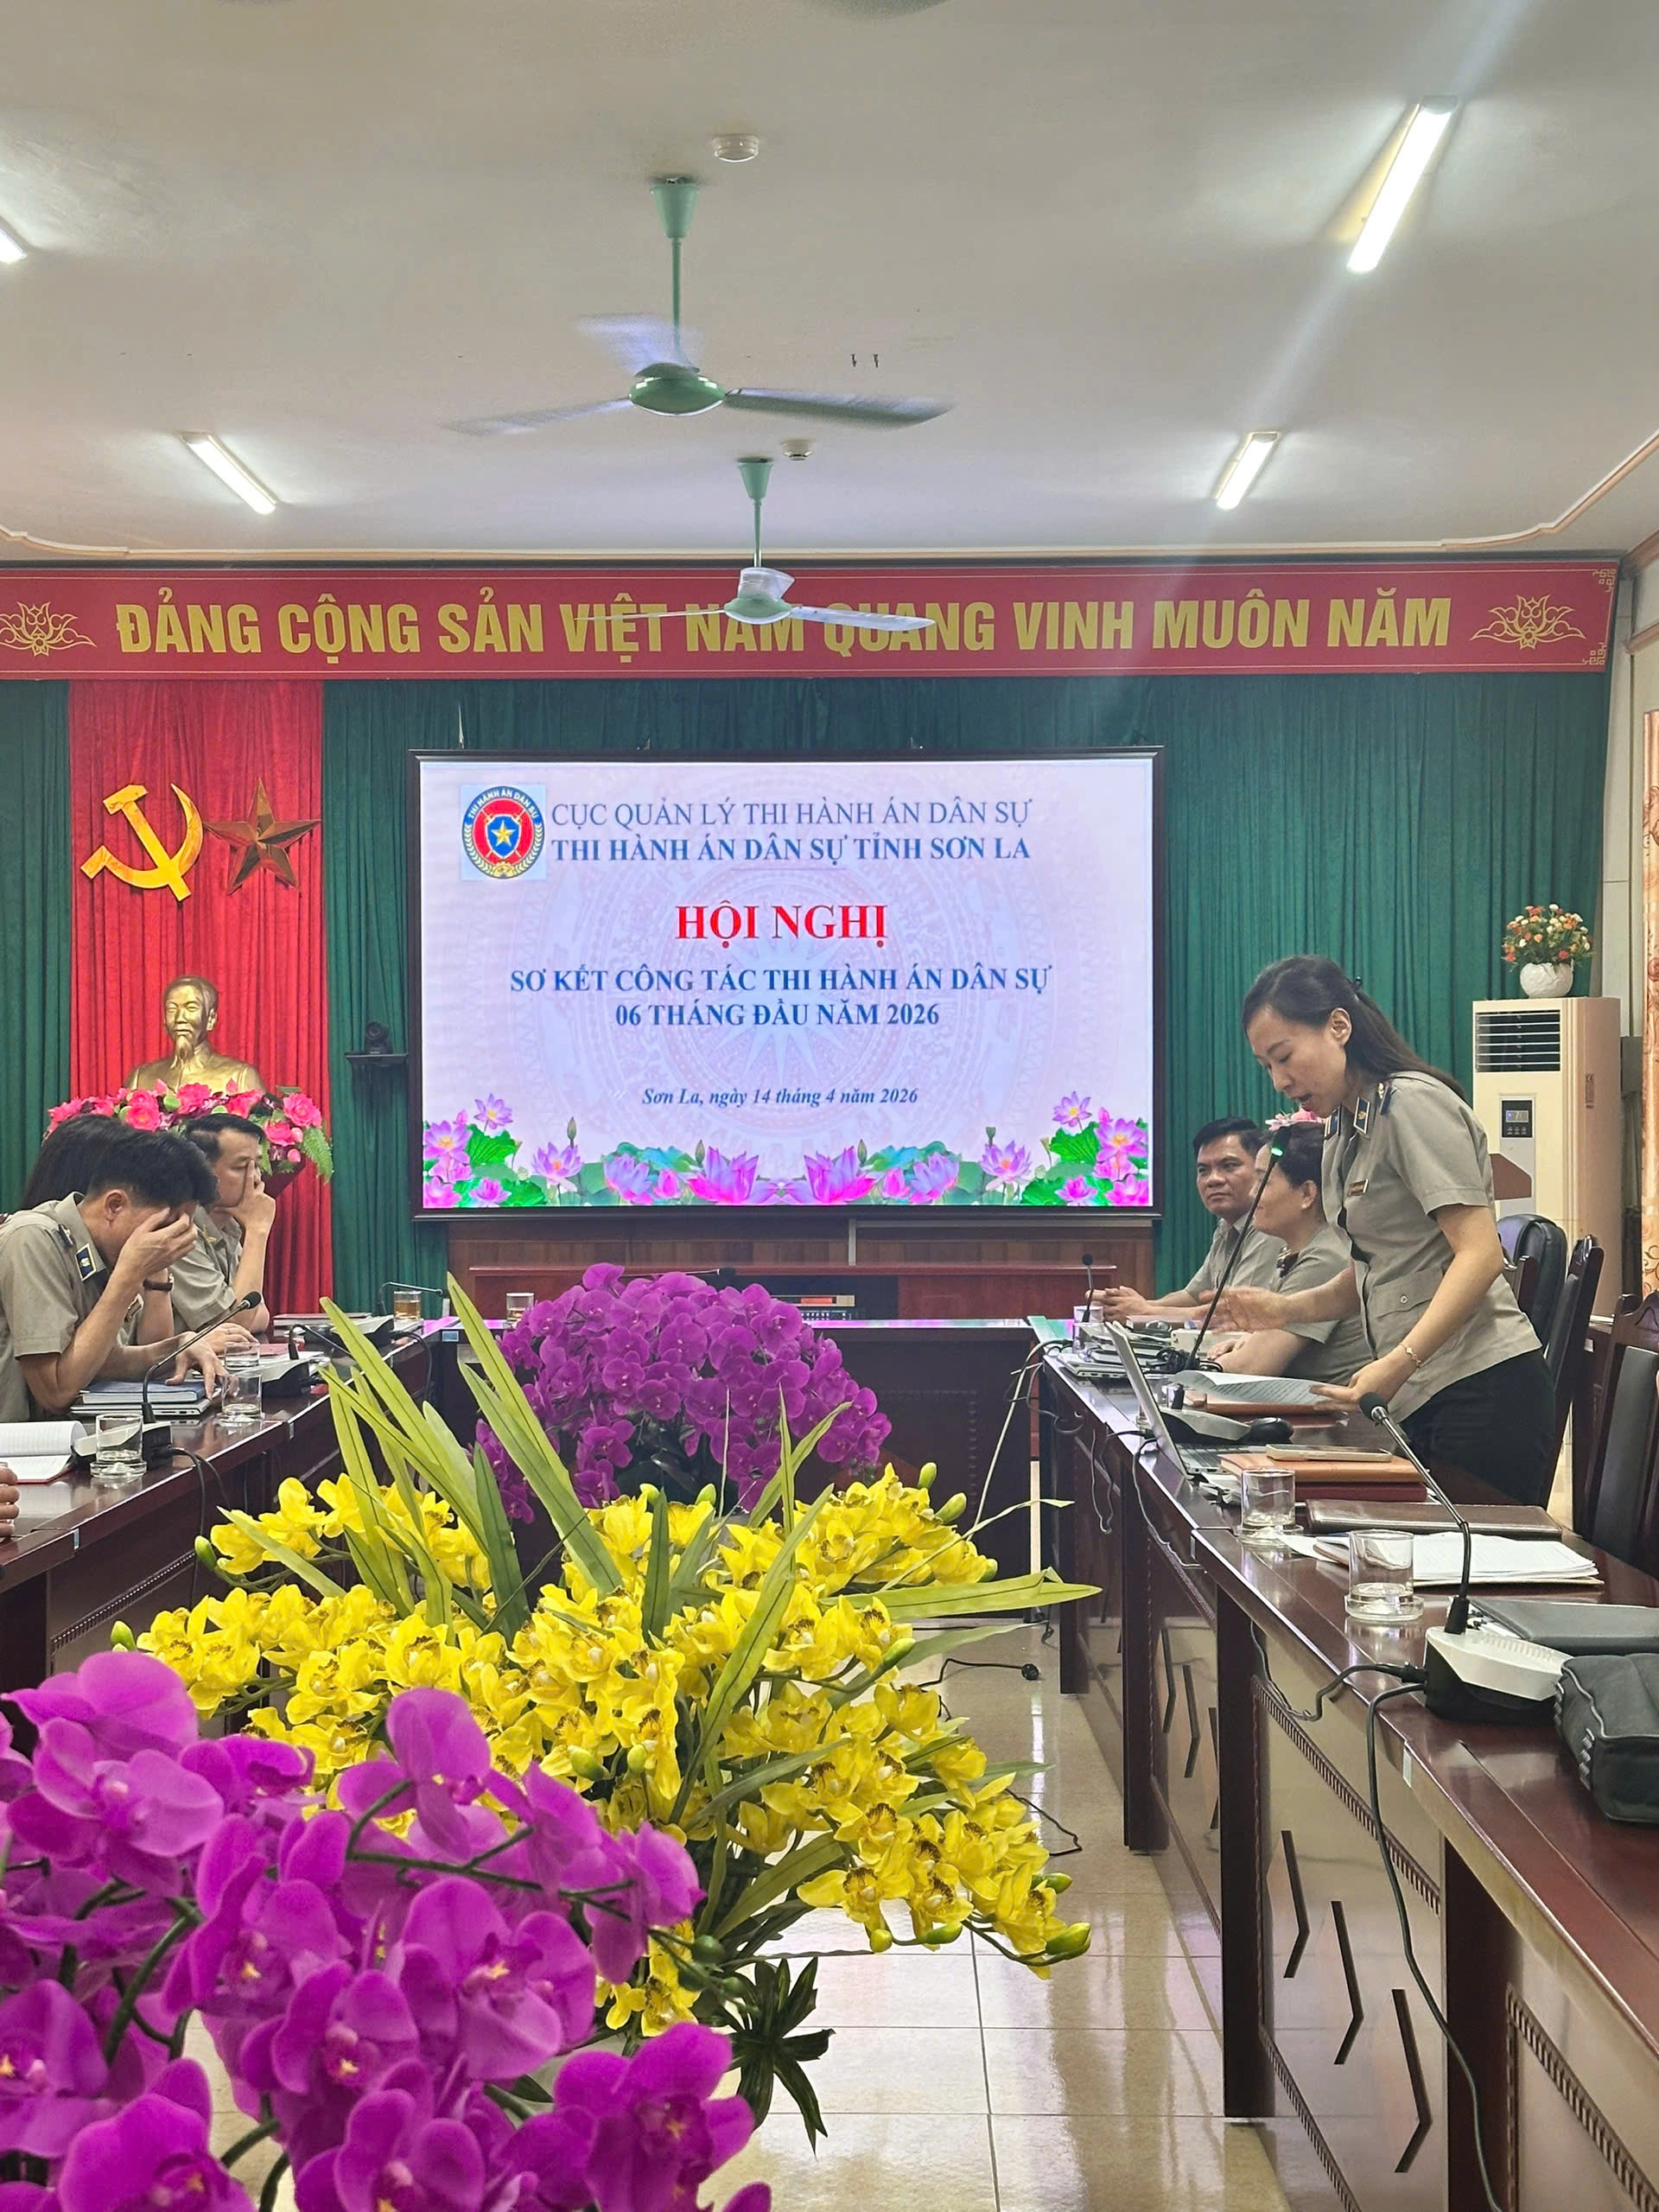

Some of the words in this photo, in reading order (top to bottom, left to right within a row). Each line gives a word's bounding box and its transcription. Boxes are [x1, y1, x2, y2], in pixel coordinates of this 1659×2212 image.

[116, 587, 262, 654] ĐẢNG
[277, 594, 421, 664] CỘNG
[437, 587, 544, 653] SẢN
[559, 593, 668, 663] VIỆT
[684, 603, 804, 652] NAM
[823, 601, 995, 658] QUANG
[1013, 601, 1134, 651] VINH
[1153, 589, 1310, 649] MUÔN
[1326, 588, 1451, 647] NĂM
[551, 804, 607, 830] CỤC
[614, 797, 692, 830] QUẢN
[702, 797, 736, 825] LÝ
[743, 803, 788, 824] THI
[797, 796, 873, 824] HÀNH
[882, 796, 920, 823] ÁN
[929, 796, 987, 823] DÂN
[995, 798, 1033, 828] SỰ
[551, 839, 601, 861] THI
[609, 833, 689, 861] HÀNH
[697, 833, 735, 861] ÁN
[745, 832, 801, 860] DÂN
[810, 835, 848, 865] SỰ
[853, 832, 921, 860] TỈNH
[930, 836, 985, 860] SƠN
[995, 837, 1031, 859] LA
[675, 899, 760, 949] HỘI
[772, 905, 888, 948] NGHỊ
[511, 968, 547, 992] SƠ
[554, 963, 608, 991] KẾT
[614, 963, 693, 992] CÔNG
[701, 963, 757, 991] TÁC
[762, 969, 810, 991] THI
[819, 963, 897, 990] HÀNH
[906, 963, 943, 990] ÁN
[951, 961, 1007, 990] DÂN
[1015, 964, 1052, 995] SỰ
[615, 1004, 642, 1027] 06
[648, 998, 745, 1026] THÁNG
[753, 998, 809, 1026] ĐẦU
[817, 998, 879, 1026] NĂM
[887, 1003, 939, 1026] 2026
[642, 1088, 674, 1105] Sơn
[678, 1088, 704, 1107] La,
[709, 1087, 748, 1109] ngày
[753, 1088, 771, 1104] 14
[775, 1087, 822, 1109] tháng
[825, 1088, 836, 1103] 4
[840, 1087, 875, 1104] năm
[880, 1088, 918, 1104] 2026
